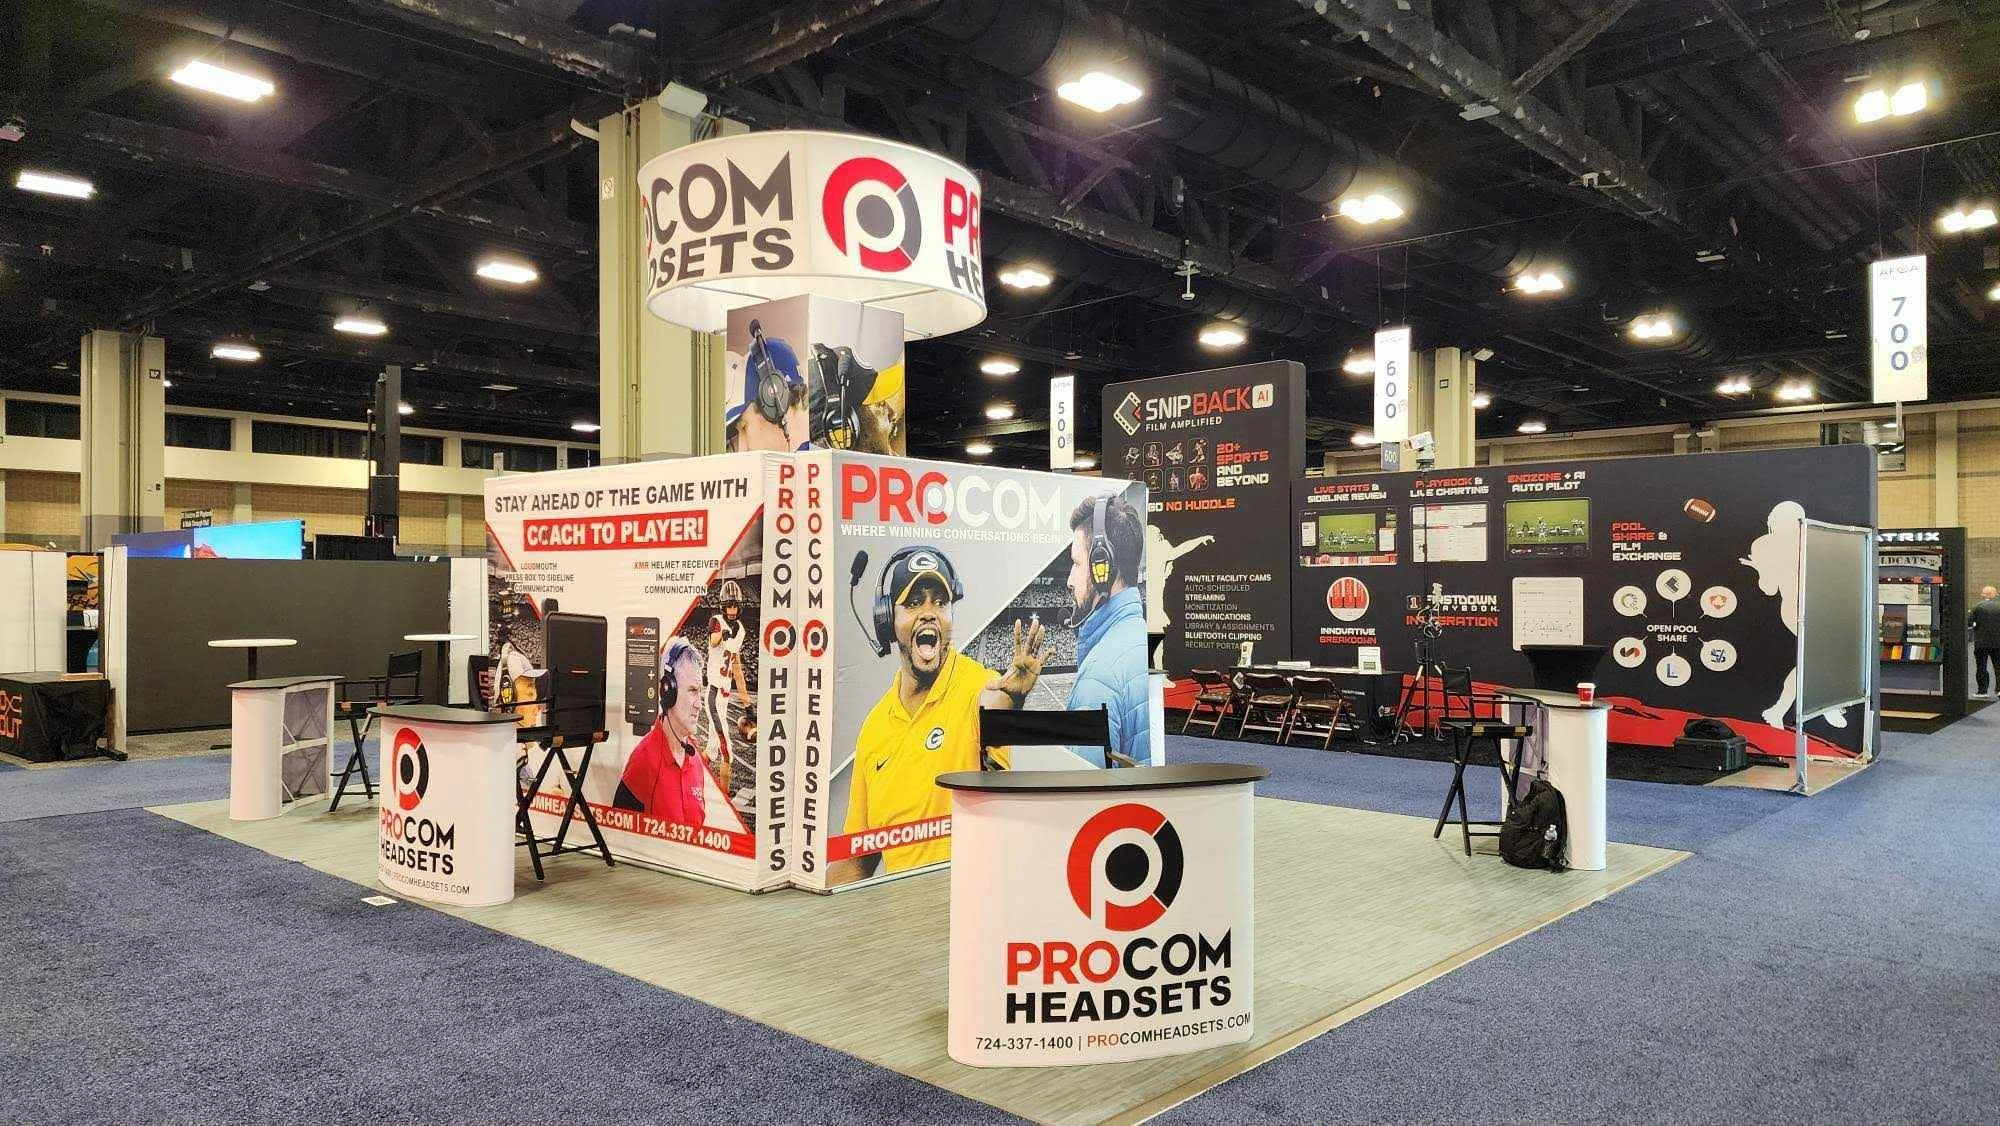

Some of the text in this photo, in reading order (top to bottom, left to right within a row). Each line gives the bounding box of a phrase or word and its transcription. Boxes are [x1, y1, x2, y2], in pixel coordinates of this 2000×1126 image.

[1891, 296, 1908, 371] 700
[1385, 361, 1397, 419] 600
[1145, 385, 1251, 421] SNIPBACK
[1058, 401, 1066, 449] 500
[1145, 416, 1222, 432] FILM AMPLIFIED
[1217, 451, 1269, 464] SPORTS
[1217, 465, 1242, 476] AND
[1217, 473, 1269, 487] BEYOND
[1507, 473, 1561, 483] ENDZONE
[1574, 471, 1585, 481] AI
[1314, 485, 1335, 494] LIVE
[1337, 484, 1369, 493] STATS
[1436, 486, 1489, 497] CHARTING
[1512, 481, 1580, 493] AUTO PILOT
[495, 478, 748, 512] STAY AHEAD OF THE GAME WITH
[841, 463, 1062, 530] PROCOM
[1308, 492, 1386, 503] SIDELINE REVIEW
[1166, 501, 1183, 511] NO
[1185, 498, 1235, 511] HUDDLE
[590, 522, 615, 544] TO
[621, 516, 704, 543] PLAYER!
[1612, 523, 1646, 531] POOL
[773, 464, 795, 608] PROCOM
[808, 464, 822, 608] PROCOM
[841, 525, 886, 538] WHERE
[889, 526, 941, 540] WINNING
[944, 528, 1030, 543] CONVERSATIONS
[1612, 532, 1655, 541] SHARE
[1612, 543, 1641, 551] FILM
[1612, 552, 1681, 561] EXCHANGE
[651, 560, 680, 569] HELMET
[681, 560, 719, 568] RECEIVER
[547, 573, 574, 581] SIDELINE
[655, 573, 695, 581] IN-HELMET
[1217, 574, 1248, 582] FACILITY
[1249, 574, 1272, 582] CAMS
[645, 586, 706, 594] COMMUNICATION
[1185, 584, 1250, 592] AUTO-SCHEDULED
[1185, 603, 1238, 611] MONETIZATION
[1185, 622, 1215, 630] LIBRARY
[1320, 627, 1376, 636] INNOVATIVE
[1647, 624, 1698, 633] OPEN POOL
[1319, 635, 1377, 644] BREAKDOWN
[1657, 634, 1688, 643] SHARE
[1185, 641, 1243, 650] RECRUIT PORTA
[768, 668, 788, 871] HEADSETS
[802, 668, 822, 873] HEADSETS
[382, 806, 455, 850] PROCOM
[644, 818, 731, 850] 724.337.1400
[381, 839, 454, 876] HEADSETS
[1007, 926, 1232, 987] PROCOM
[1006, 975, 1232, 1024] HEADSETS
[975, 1036, 1073, 1051] 724-337-1400
[1087, 1012, 1251, 1048] PROCOMHEADSETS.COM
